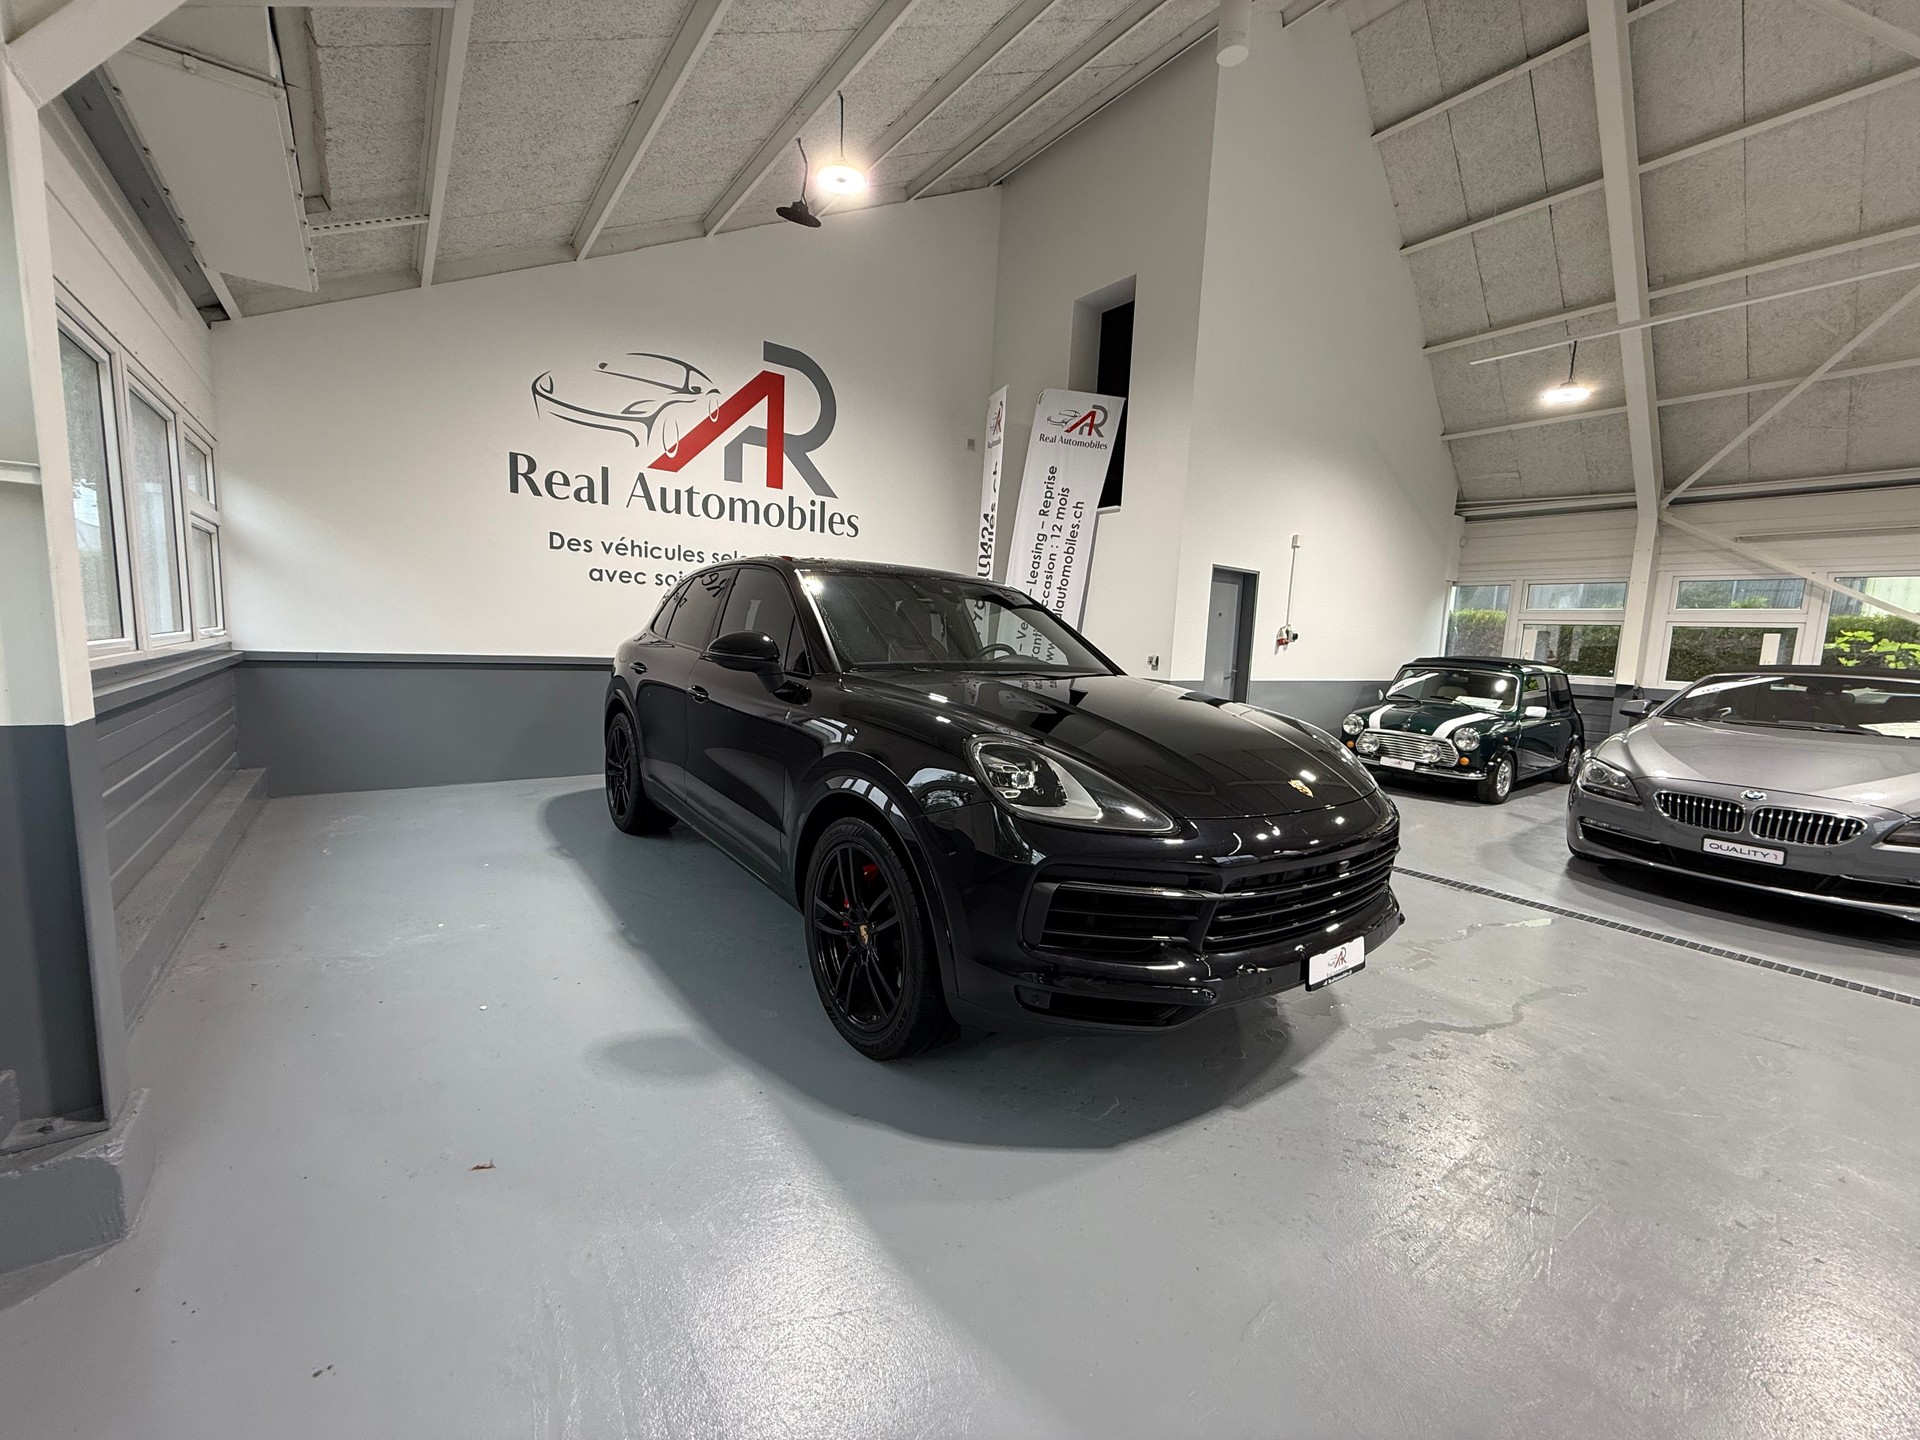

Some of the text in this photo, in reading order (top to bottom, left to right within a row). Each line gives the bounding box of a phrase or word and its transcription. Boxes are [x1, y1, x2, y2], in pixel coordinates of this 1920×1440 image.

[1039, 433, 1108, 450] Real Automobiles
[509, 451, 860, 538] Real Automobiles
[1056, 487, 1070, 520] mois
[1026, 533, 1047, 585] Leasing
[1038, 466, 1057, 517] Reprise
[1050, 524, 1063, 539] 12
[549, 531, 593, 553] Des
[601, 537, 705, 564] véhicules
[588, 567, 647, 585] avec
[1041, 553, 1057, 608] ccasion
[1709, 842, 1770, 858] QUALITY
